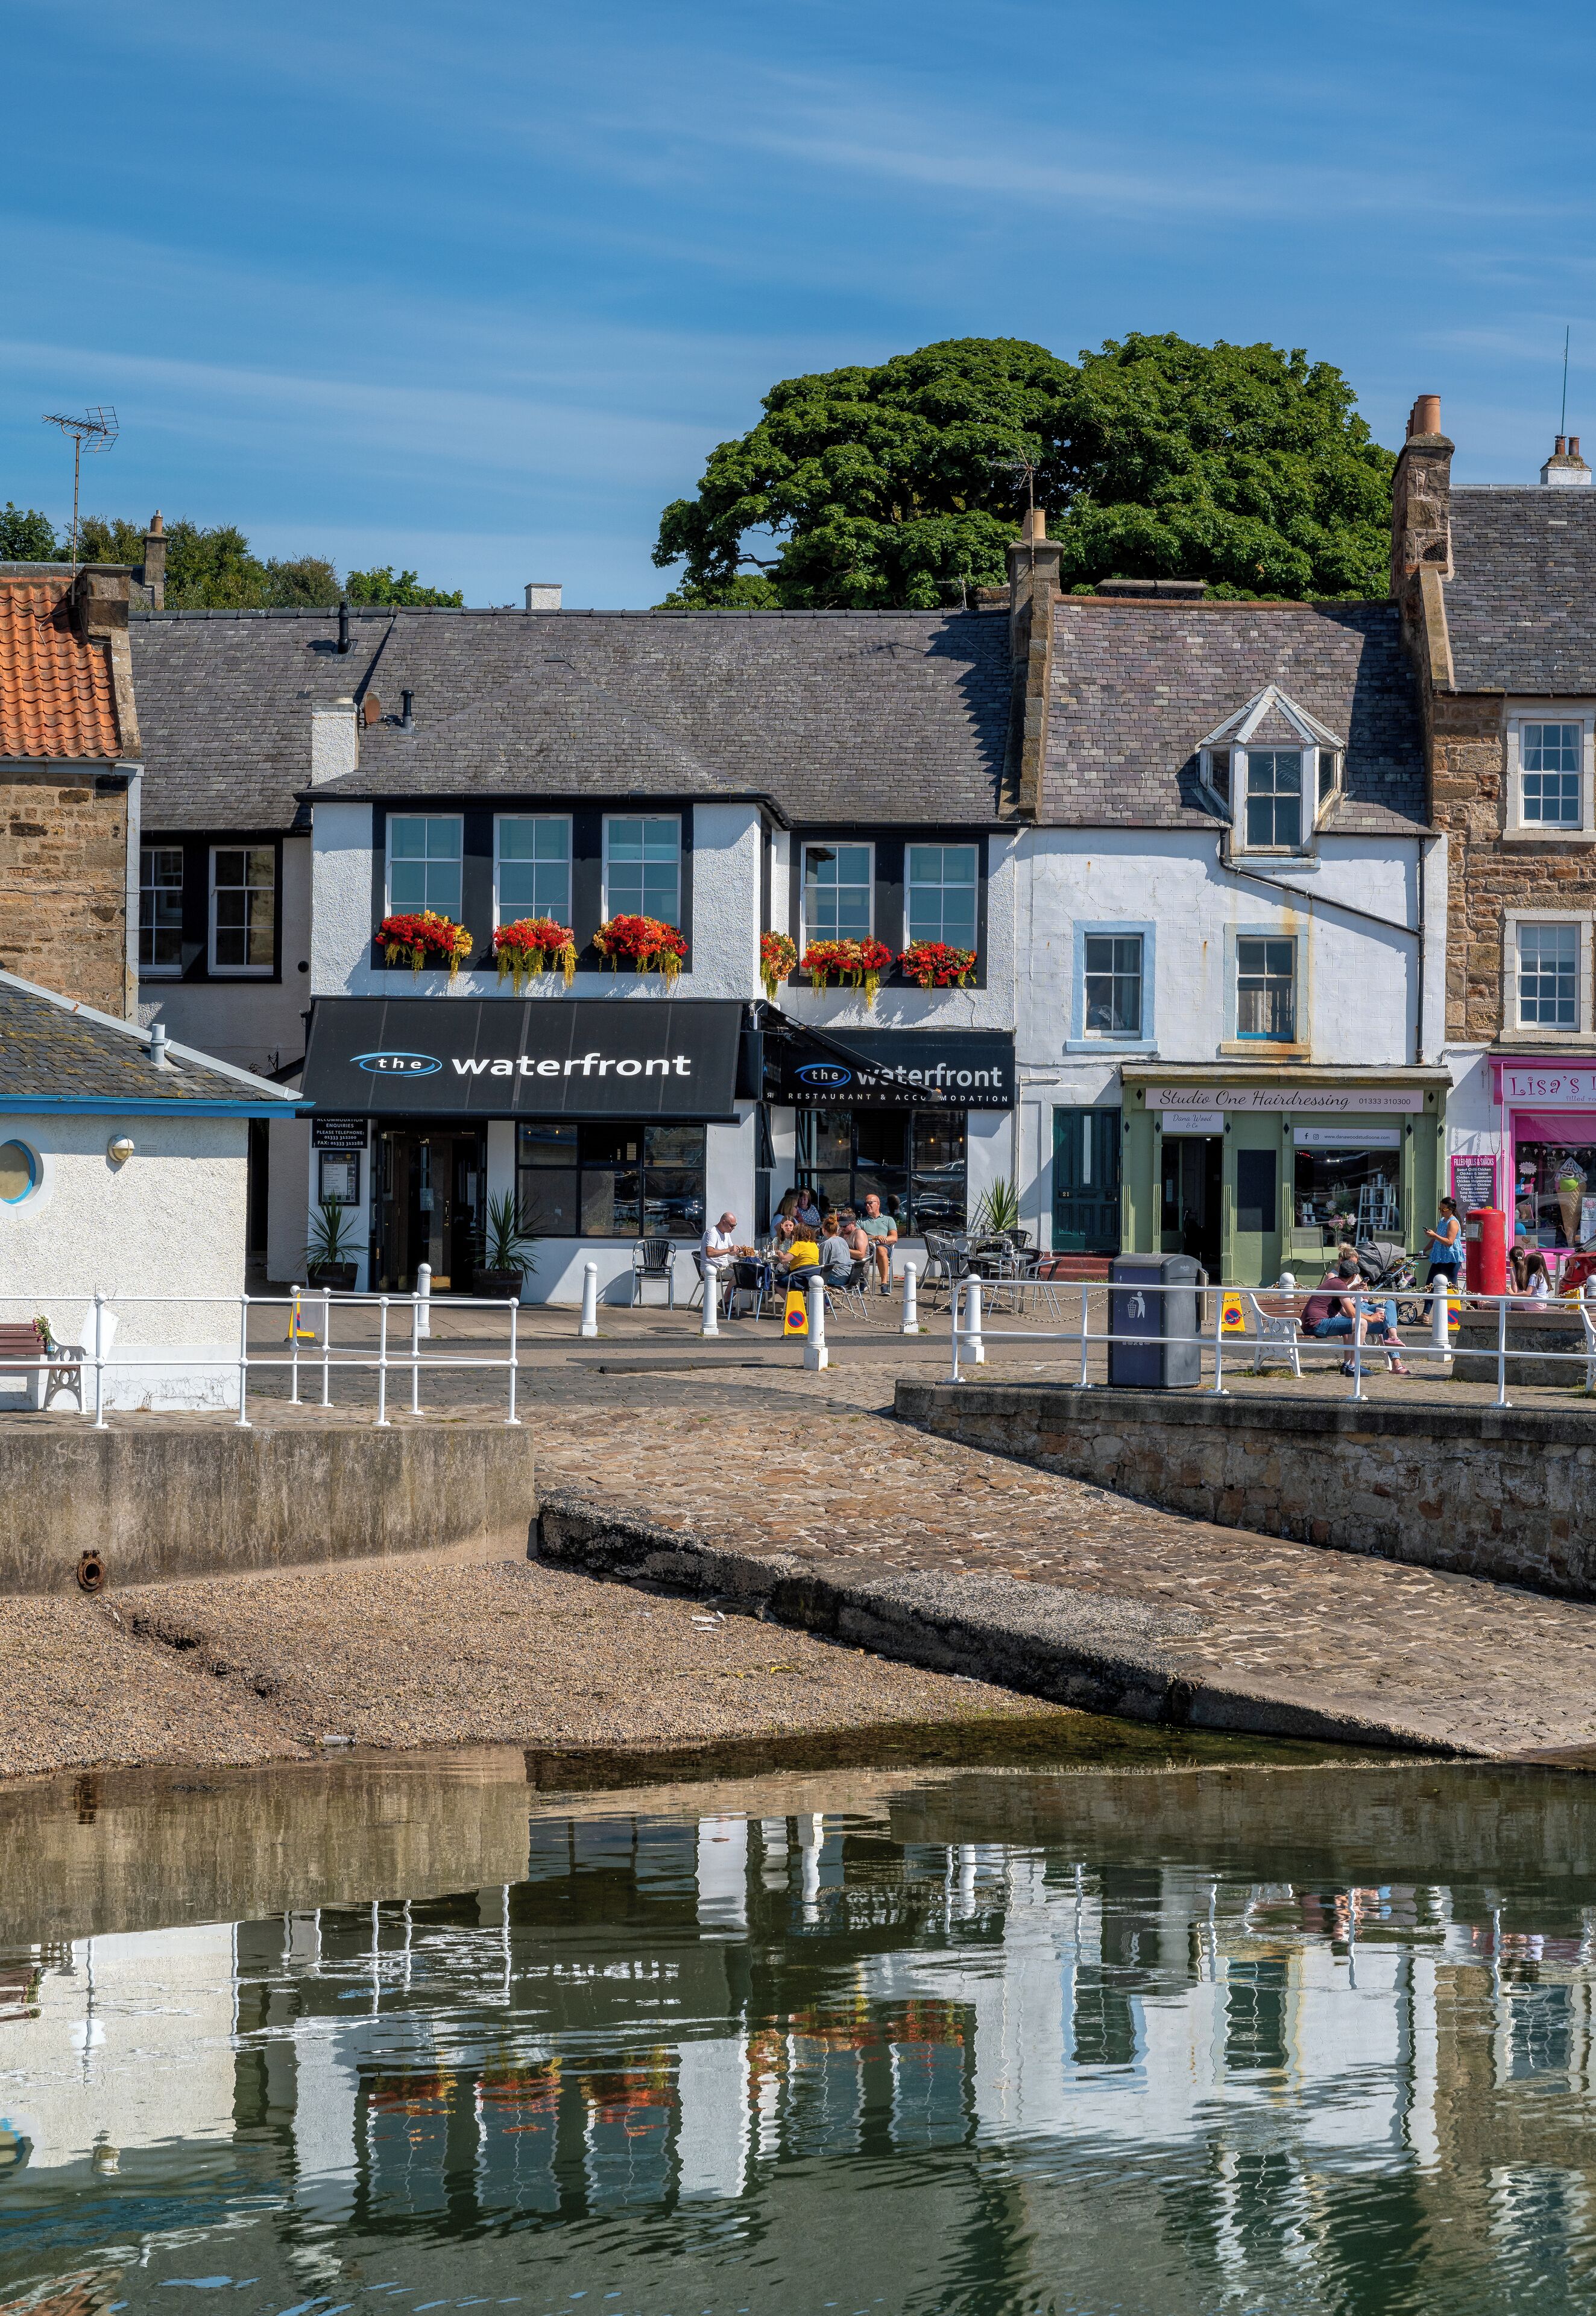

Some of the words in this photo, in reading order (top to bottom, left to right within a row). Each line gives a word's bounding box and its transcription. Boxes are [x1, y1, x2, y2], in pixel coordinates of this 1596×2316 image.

[378, 1058, 421, 1069] the
[451, 1052, 692, 1076] waterfront
[812, 1069, 838, 1080] the
[1509, 1076, 1580, 1095] Lisa's
[1160, 1089, 1211, 1105] Studio
[1216, 1090, 1247, 1106] One
[1252, 1090, 1350, 1109] Hairdressing
[1173, 1113, 1191, 1122] Dana
